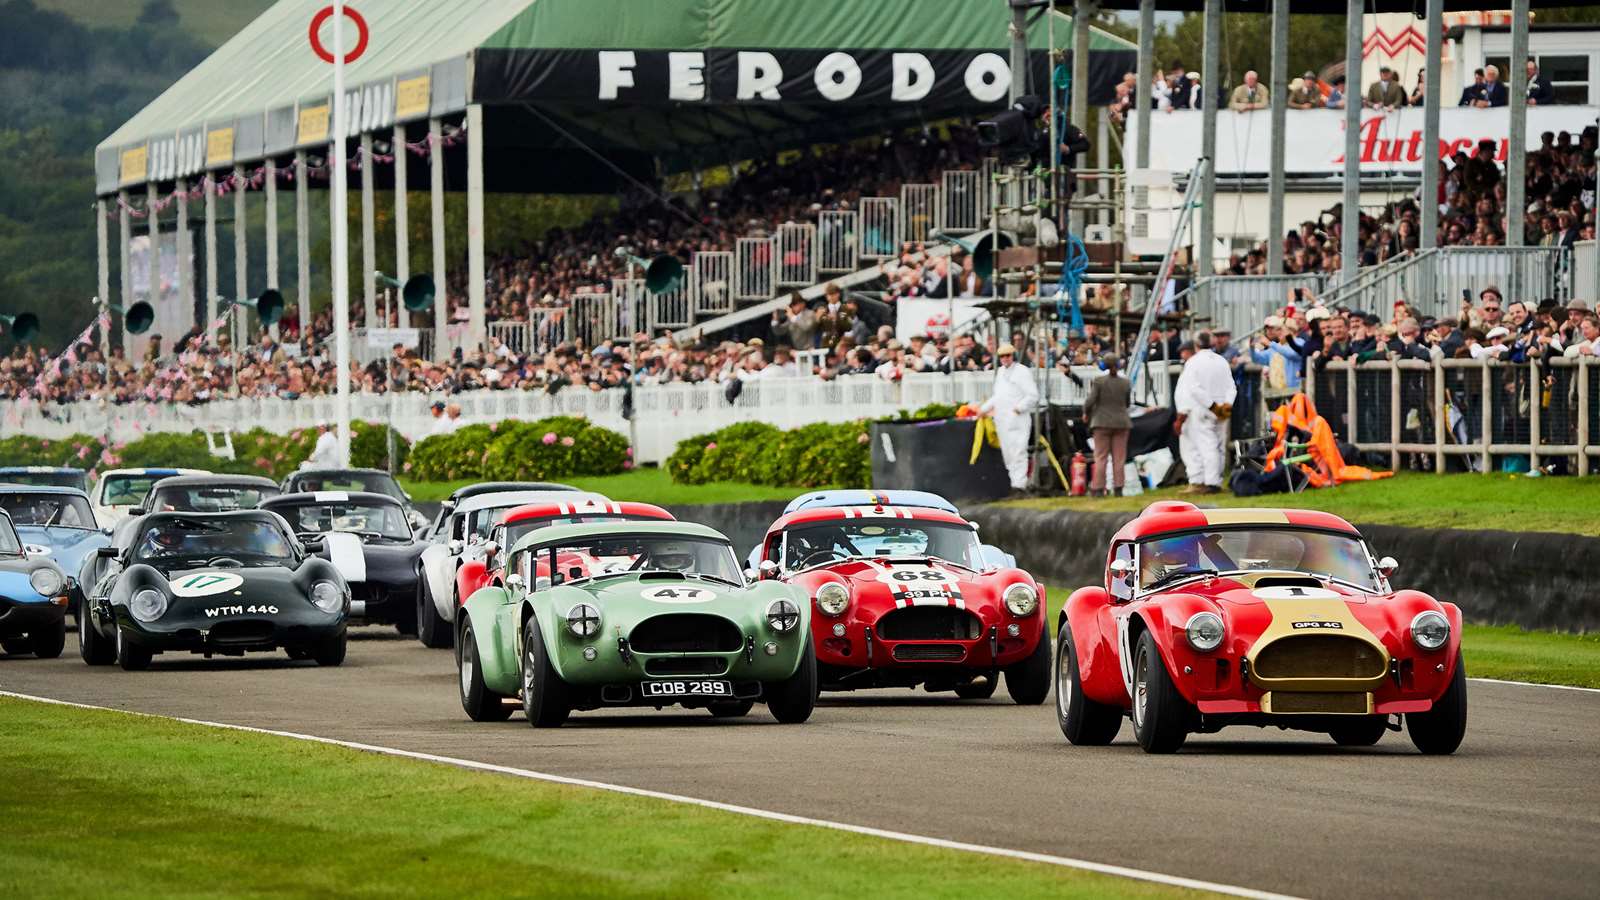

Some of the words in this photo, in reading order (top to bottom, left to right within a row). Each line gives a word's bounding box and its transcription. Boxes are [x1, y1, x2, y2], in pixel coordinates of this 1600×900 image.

[599, 50, 1012, 102] FERODO
[182, 575, 231, 588] 17
[892, 570, 946, 581] 68
[653, 588, 702, 598] 47
[204, 606, 243, 618] WTM
[650, 682, 686, 694] COB
[689, 681, 725, 694] 289
